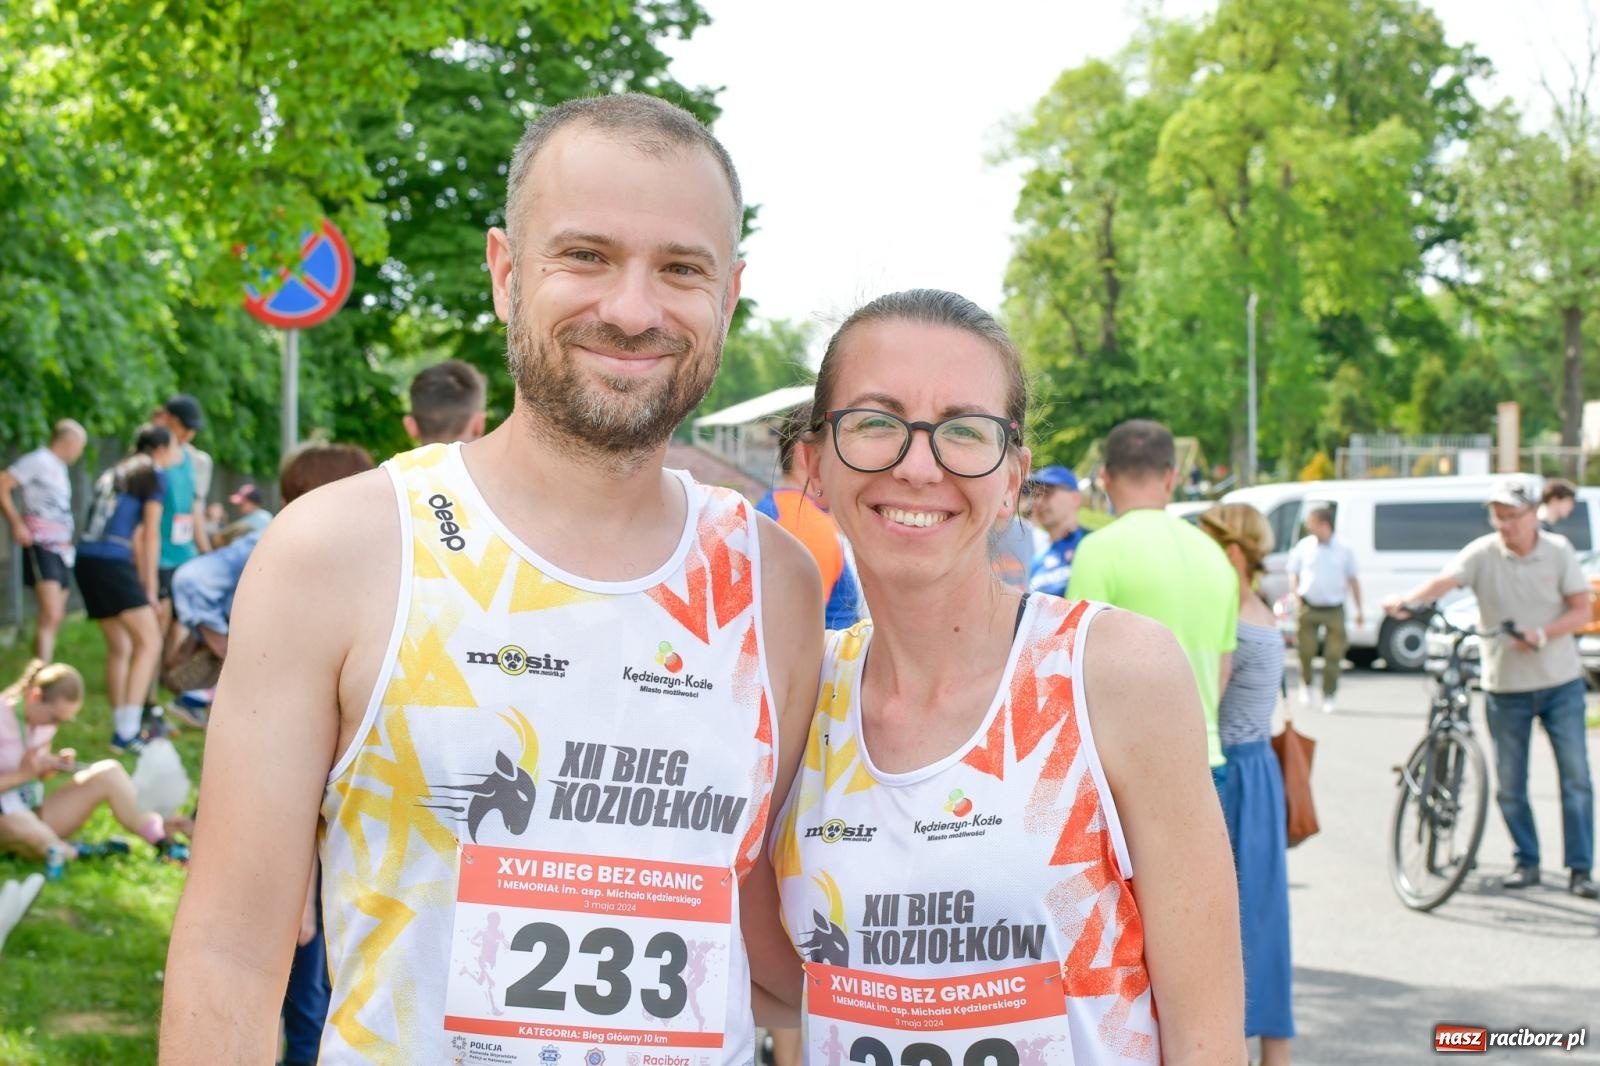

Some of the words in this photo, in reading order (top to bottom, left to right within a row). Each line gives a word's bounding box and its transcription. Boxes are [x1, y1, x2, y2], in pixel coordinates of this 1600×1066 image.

[428, 493, 466, 552] deep
[622, 666, 714, 690] Kędzierzyn-Koźle
[640, 685, 662, 694] Miasto
[558, 740, 607, 780] XII
[609, 745, 689, 786] BIEG
[547, 779, 748, 835] KOZIOŁKÓW
[913, 813, 1003, 834] Kędzierzyn-Koźle
[927, 833, 948, 841] Miasto
[497, 856, 537, 877] XVI
[541, 860, 593, 881] BIEG
[597, 865, 635, 885] BEZ
[639, 869, 704, 891] GRANIC
[503, 879, 560, 893] MEMORIAŁ
[561, 884, 579, 895] im.
[581, 888, 605, 898] asp.
[606, 889, 645, 900] Michała
[646, 892, 702, 908] Kędzierskiego
[584, 900, 589, 908] 3
[591, 902, 615, 911] maja
[616, 902, 637, 912] 2024
[863, 894, 900, 927] XII
[902, 889, 975, 927] BIEG
[855, 918, 1047, 966] KOZIOŁKÓW
[504, 921, 688, 1019] 233
[830, 974, 858, 994] XVI
[861, 979, 898, 1000] BIEG
[900, 986, 937, 1004] BEZ
[940, 976, 1027, 1002] GRANIC
[836, 996, 876, 1010] MEMORIAŁ
[876, 1002, 890, 1012] im.
[891, 1007, 910, 1017] asp.
[911, 1007, 952, 1017] Michała
[953, 996, 1027, 1015] Kędzierskiego
[895, 1017, 901, 1026] 3
[901, 1018, 922, 1028] maja
[923, 1019, 944, 1028] 2024
[470, 1041, 502, 1052] POLICJA
[518, 1026, 581, 1040] KATEGORIA:
[582, 1030, 605, 1043] Bieg
[606, 1032, 642, 1044] Główny
[644, 1034, 653, 1043] 10
[654, 1034, 668, 1043] km
[643, 1055, 690, 1066] Racibórz
